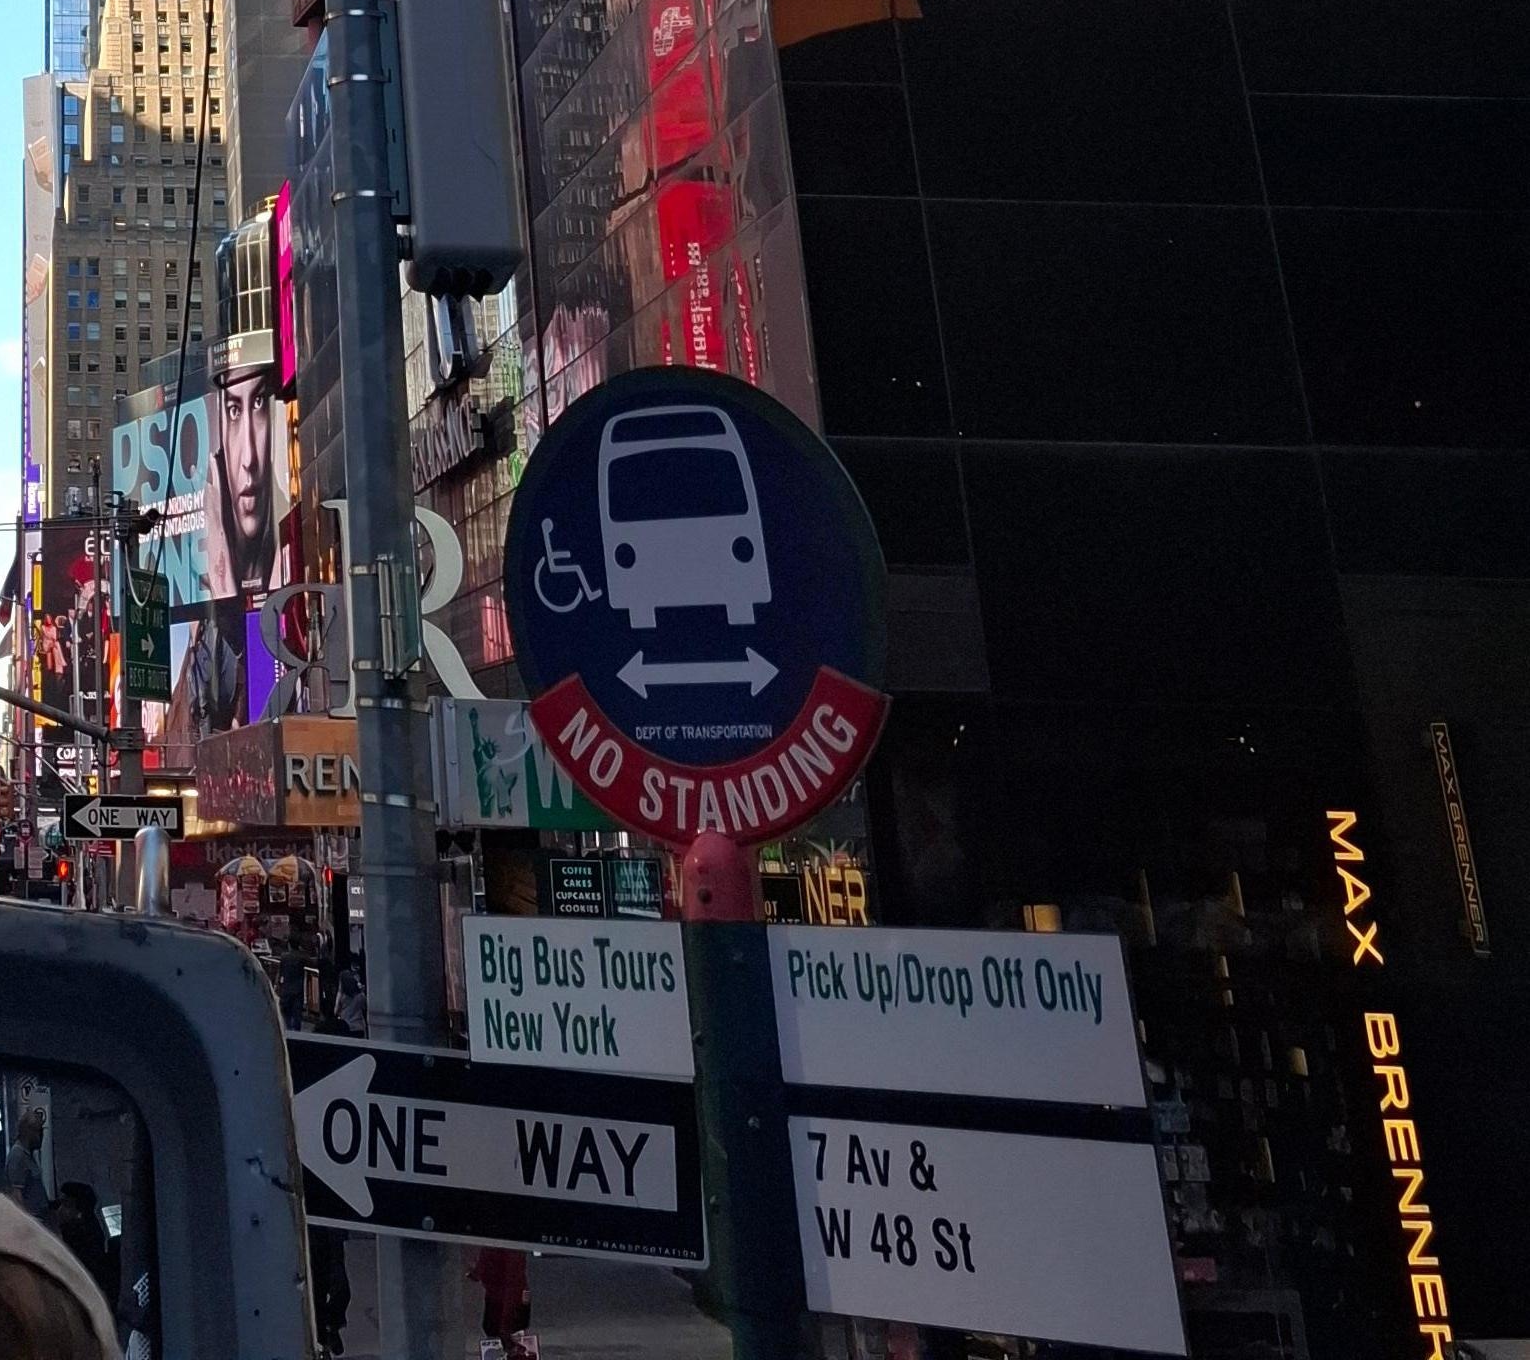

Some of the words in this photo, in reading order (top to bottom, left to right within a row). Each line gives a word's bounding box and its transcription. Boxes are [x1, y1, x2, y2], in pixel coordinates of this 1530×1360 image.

[635, 726, 663, 740] DEPT
[664, 725, 680, 739] OF
[680, 724, 773, 740] TRANSPORTATION
[557, 706, 623, 788] NO
[638, 703, 859, 833] STANDING
[88, 808, 120, 826] ONE
[136, 808, 171, 827] WAY
[1433, 729, 1457, 796] MAX
[1448, 800, 1485, 945] BRENNER
[555, 891, 602, 901] CUPCAKES
[561, 866, 593, 875] COFFEE
[563, 879, 593, 888] CAKES
[559, 904, 600, 914] COOKIES
[479, 933, 523, 996] Big
[532, 935, 586, 989] Bus
[592, 937, 676, 993] Tours
[787, 949, 848, 1001] Pick
[853, 952, 973, 1019] Up/Drop
[981, 955, 1026, 1009] Off
[1034, 957, 1102, 1025] Only
[483, 998, 543, 1052] New
[552, 1001, 620, 1057] York
[1325, 809, 1385, 966] MAX
[1364, 1011, 1454, 1360] BRENNER
[322, 1097, 448, 1177] ONE
[514, 1118, 651, 1198] WAY
[807, 1131, 827, 1181] 7
[846, 1134, 890, 1188] Av
[909, 1140, 938, 1192] &
[814, 1205, 851, 1259] W
[870, 1212, 918, 1267] 48
[931, 1216, 976, 1273] St
